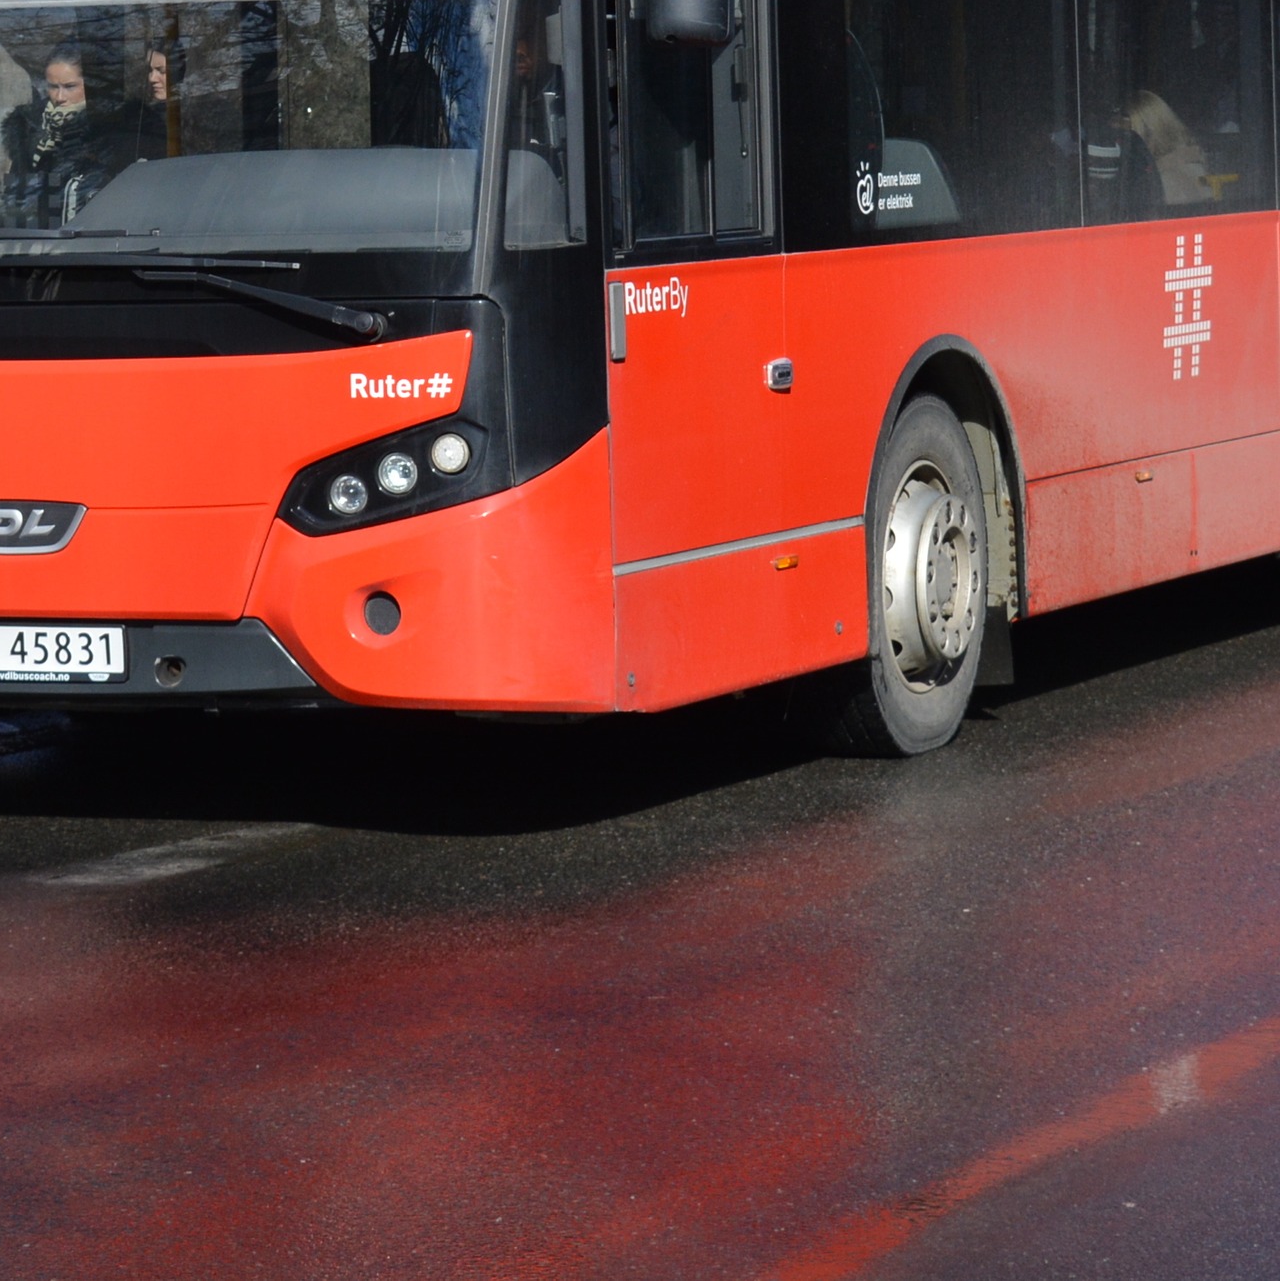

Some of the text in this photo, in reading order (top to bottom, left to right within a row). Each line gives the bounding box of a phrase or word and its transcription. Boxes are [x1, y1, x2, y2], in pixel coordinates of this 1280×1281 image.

[877, 171, 921, 188] Denne bussen
[878, 193, 913, 210] er elektrisk
[349, 372, 453, 399] Ruter#
[10, 631, 112, 666] 45831
